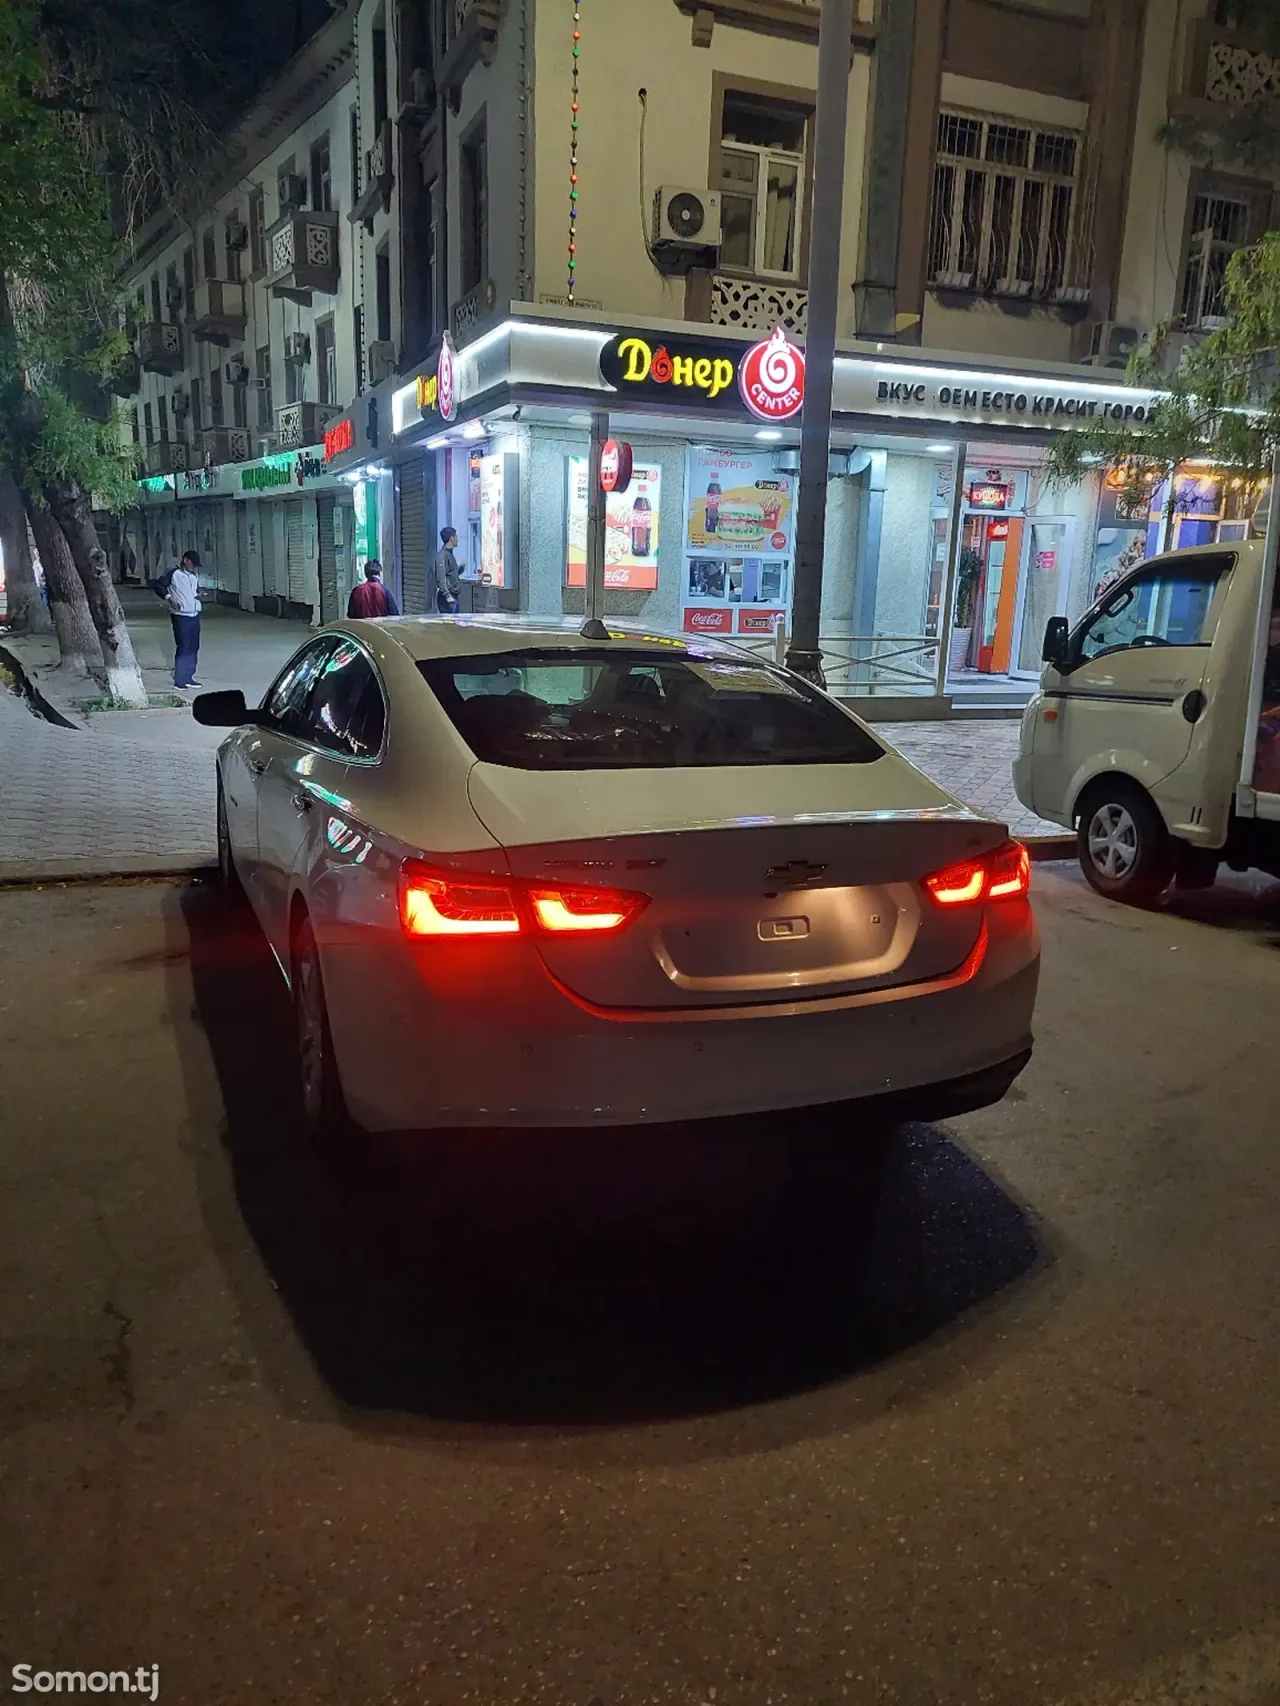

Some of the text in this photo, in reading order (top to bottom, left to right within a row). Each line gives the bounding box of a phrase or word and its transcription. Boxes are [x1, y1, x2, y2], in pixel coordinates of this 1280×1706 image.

[751, 383, 802, 411] CENTER
[1032, 395, 1098, 417] КРАСИТ
[698, 458, 753, 470] ГАМБУРГЕР
[691, 613, 724, 625] Coca-Cola
